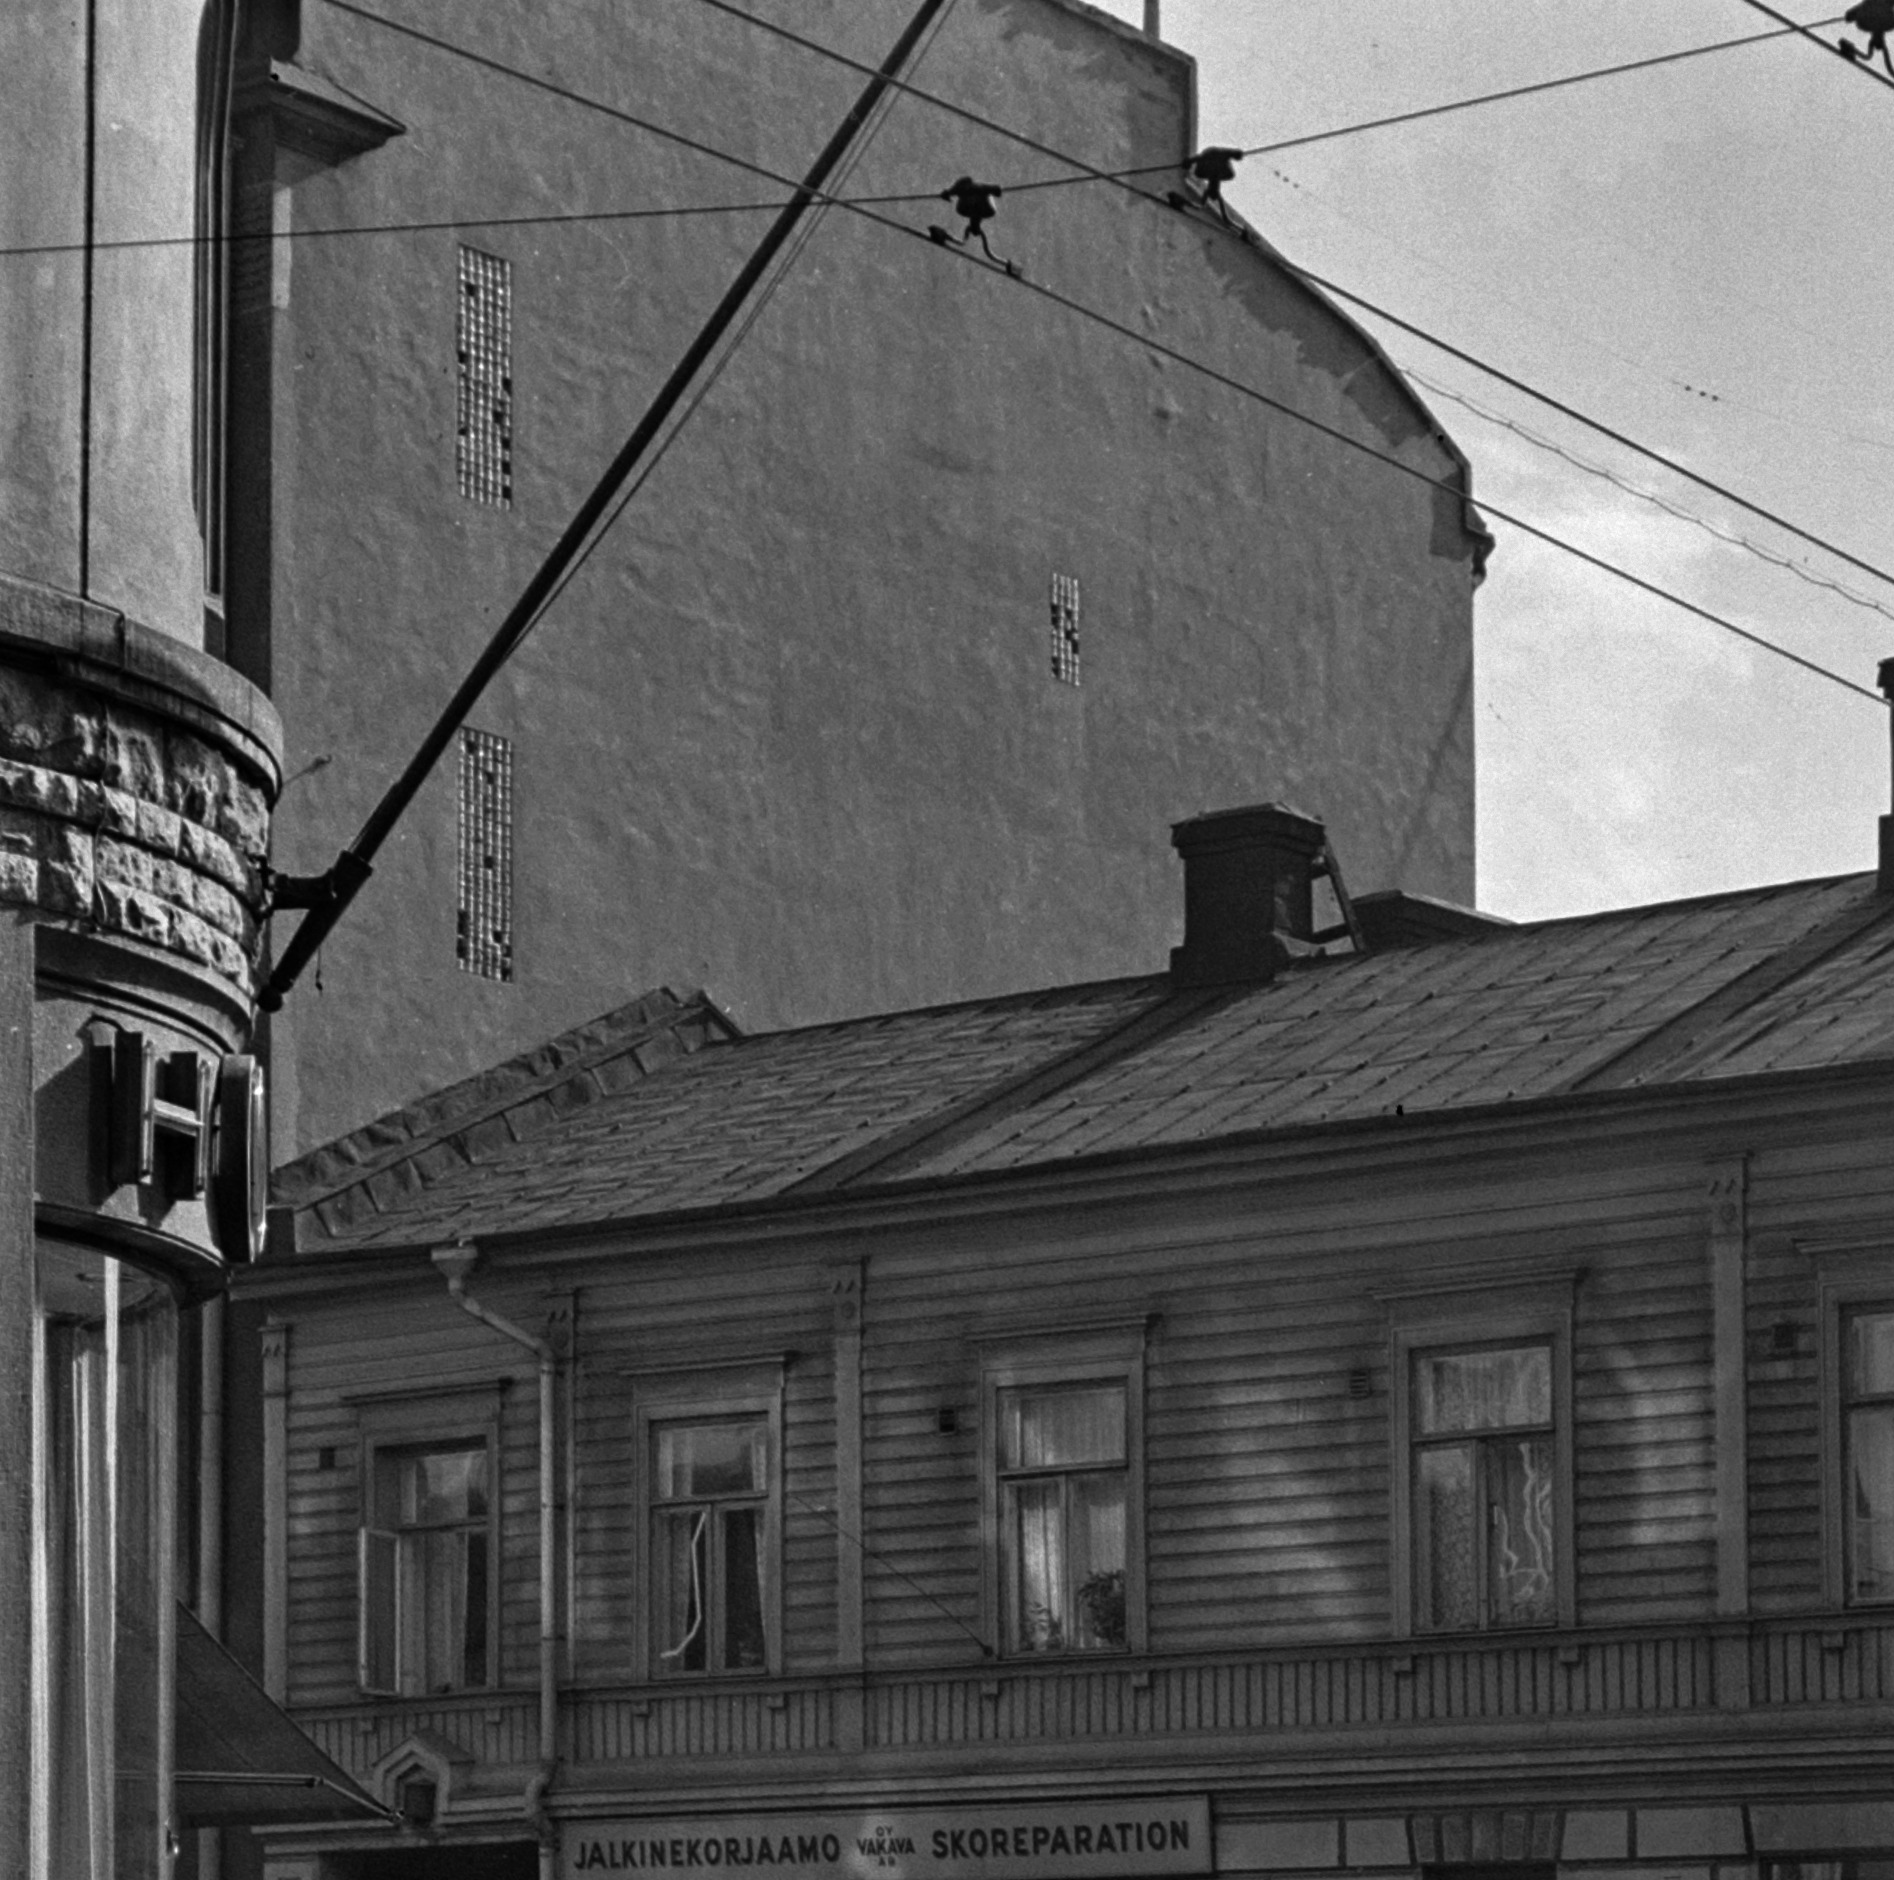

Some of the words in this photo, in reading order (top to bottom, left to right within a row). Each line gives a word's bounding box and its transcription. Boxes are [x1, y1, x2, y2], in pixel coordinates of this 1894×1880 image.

[573, 1832, 841, 1870] JALKINEKORJAAMO
[856, 1837, 916, 1856] VAKAVA
[931, 1819, 1190, 1860] SKOREPARATION
